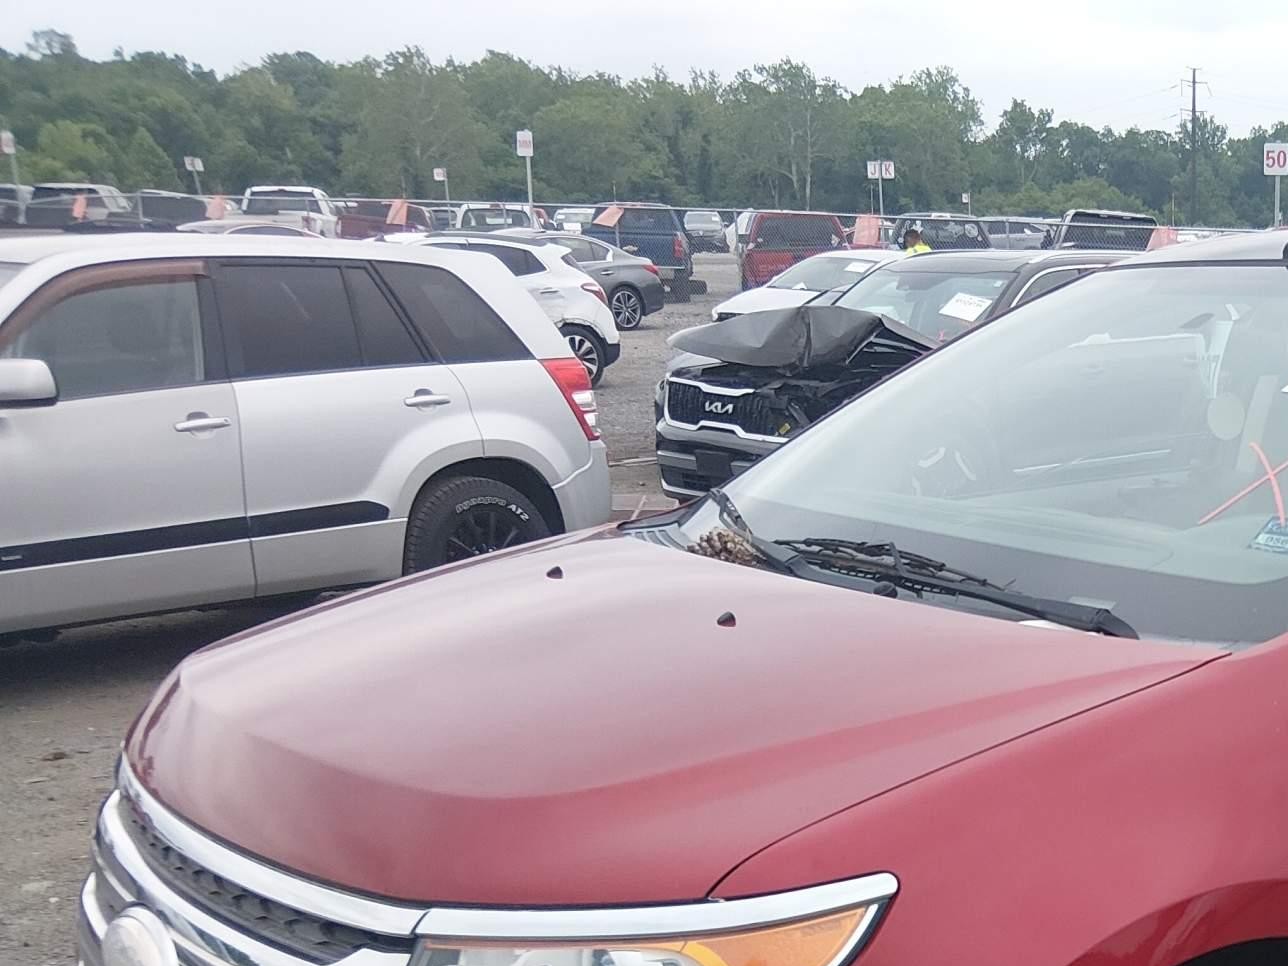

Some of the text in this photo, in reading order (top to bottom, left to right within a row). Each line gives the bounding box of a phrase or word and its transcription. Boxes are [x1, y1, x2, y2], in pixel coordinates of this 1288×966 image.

[1265, 150, 1287, 168] 50
[870, 163, 892, 176] J K
[704, 400, 734, 414] KIA
